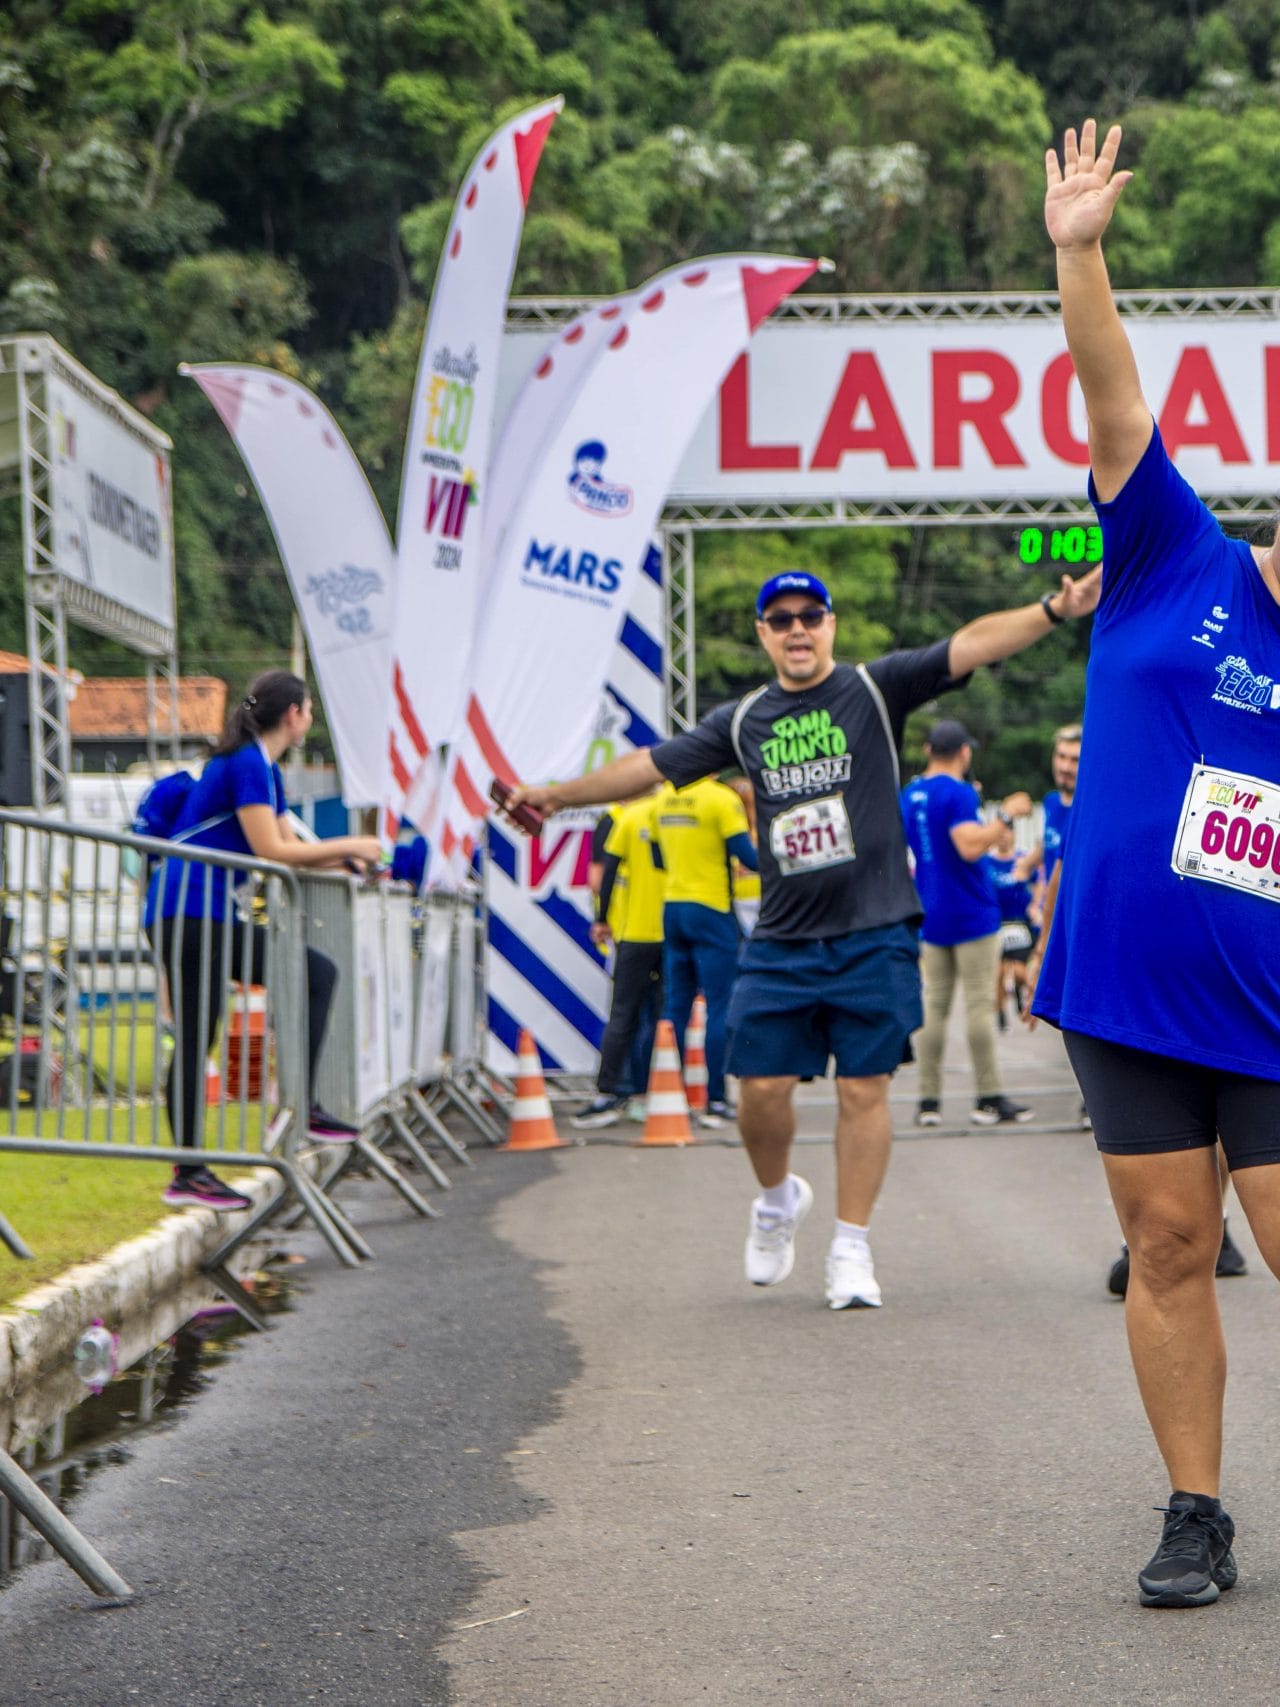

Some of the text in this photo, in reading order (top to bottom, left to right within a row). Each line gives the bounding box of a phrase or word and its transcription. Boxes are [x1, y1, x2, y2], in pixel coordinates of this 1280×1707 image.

[425, 375, 474, 452] ECO
[424, 474, 472, 540] VII
[523, 538, 623, 593] MARS
[1211, 693, 1262, 715] AMBIENTAL
[1216, 664, 1272, 706] ECO
[1207, 784, 1258, 810] ECO VII
[784, 822, 839, 859] 5271
